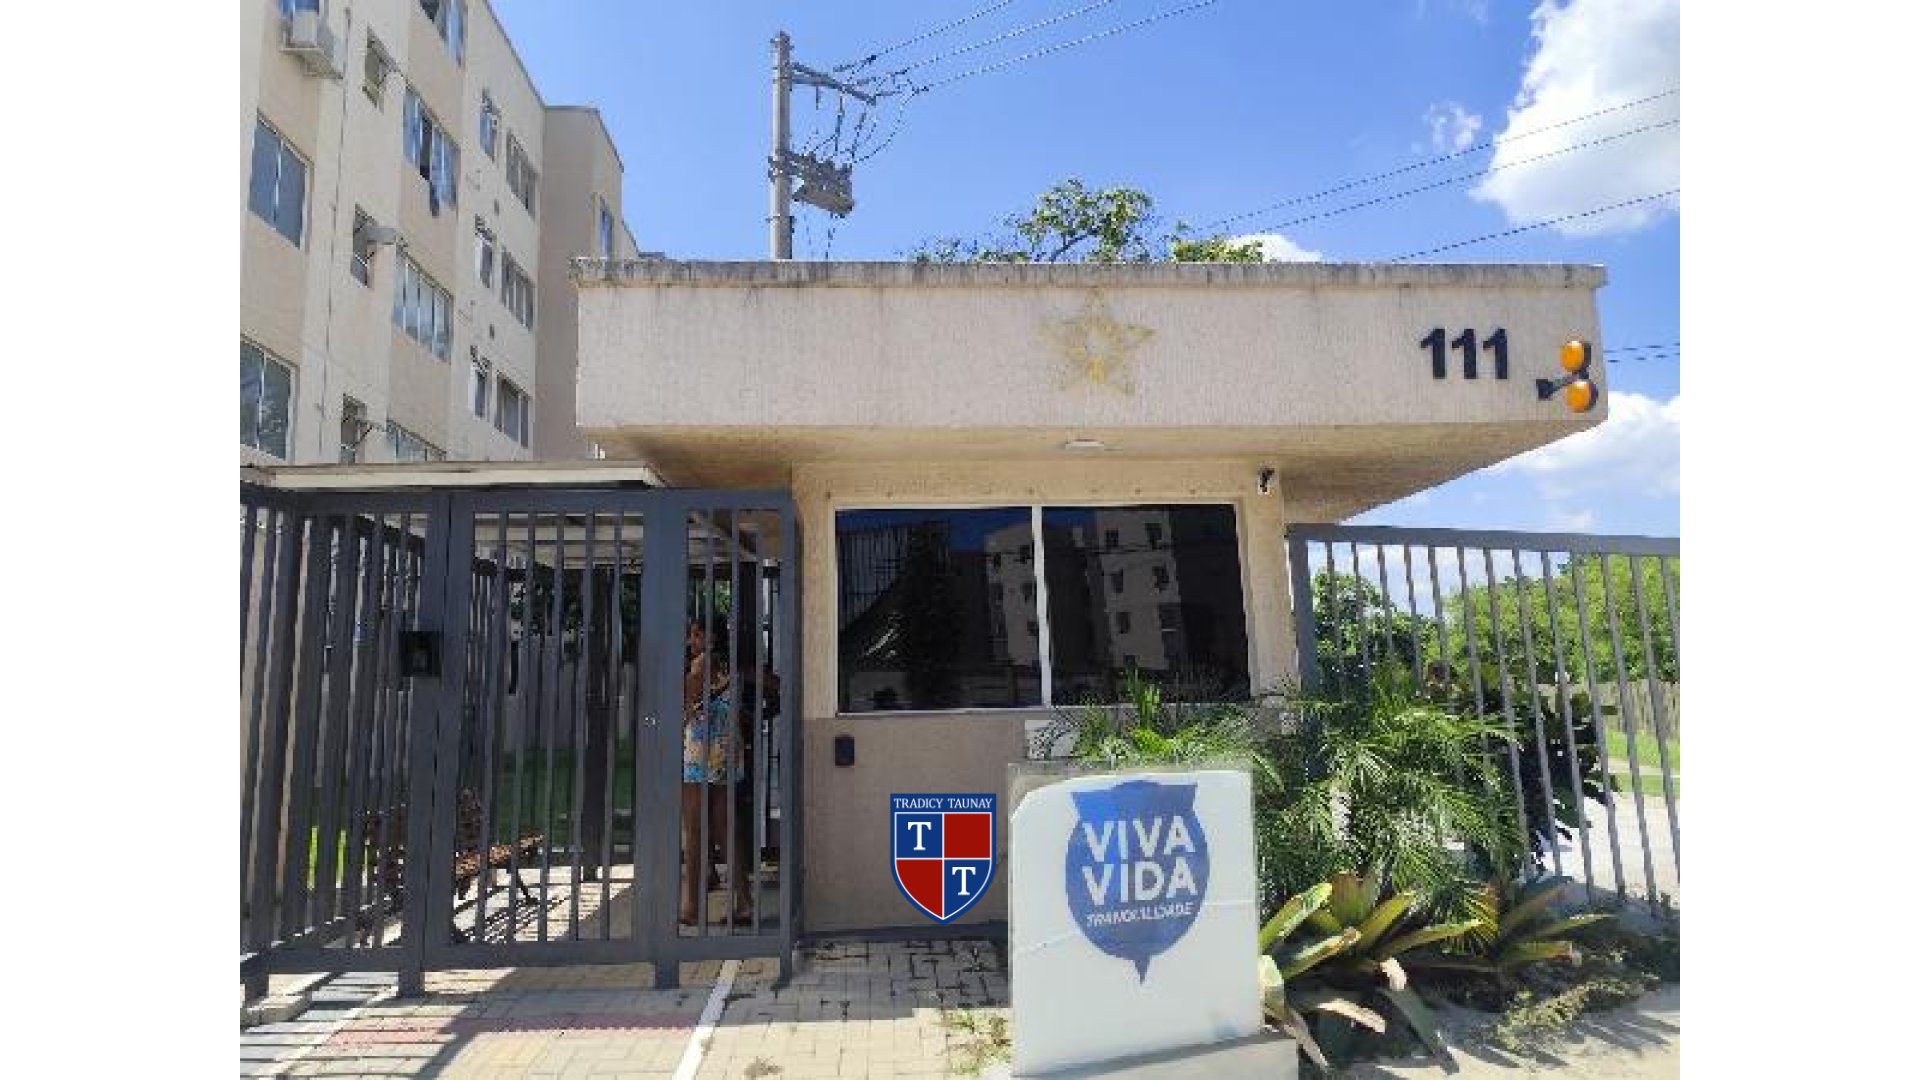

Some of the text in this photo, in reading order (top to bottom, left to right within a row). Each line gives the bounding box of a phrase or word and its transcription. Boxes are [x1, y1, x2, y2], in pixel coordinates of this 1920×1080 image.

[1420, 328, 1508, 380] 111
[1081, 815, 1196, 863] VIVA
[1081, 856, 1199, 906] VIDA
